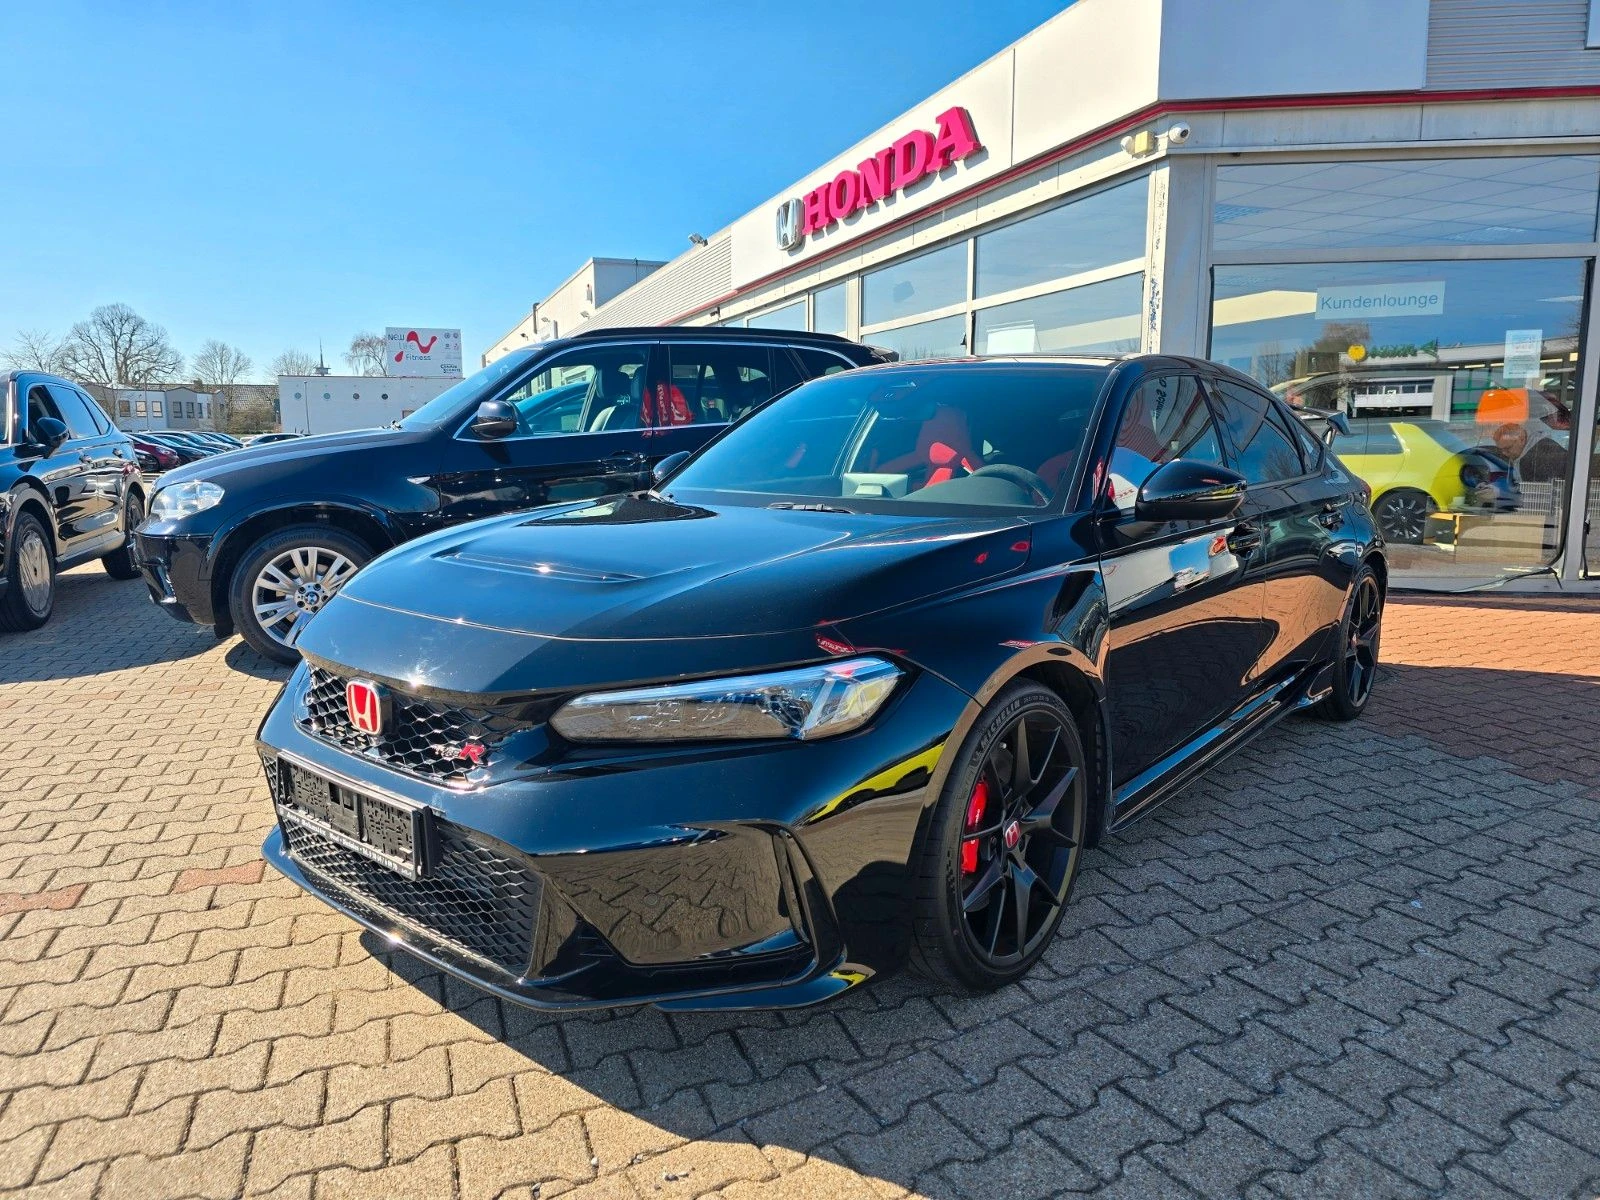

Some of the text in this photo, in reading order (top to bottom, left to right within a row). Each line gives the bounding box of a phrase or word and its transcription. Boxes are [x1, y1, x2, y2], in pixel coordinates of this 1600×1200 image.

[802, 106, 981, 236] HONDA
[1321, 294, 1438, 310] Kundenlounge
[980, 699, 1020, 749] MICHELIN
